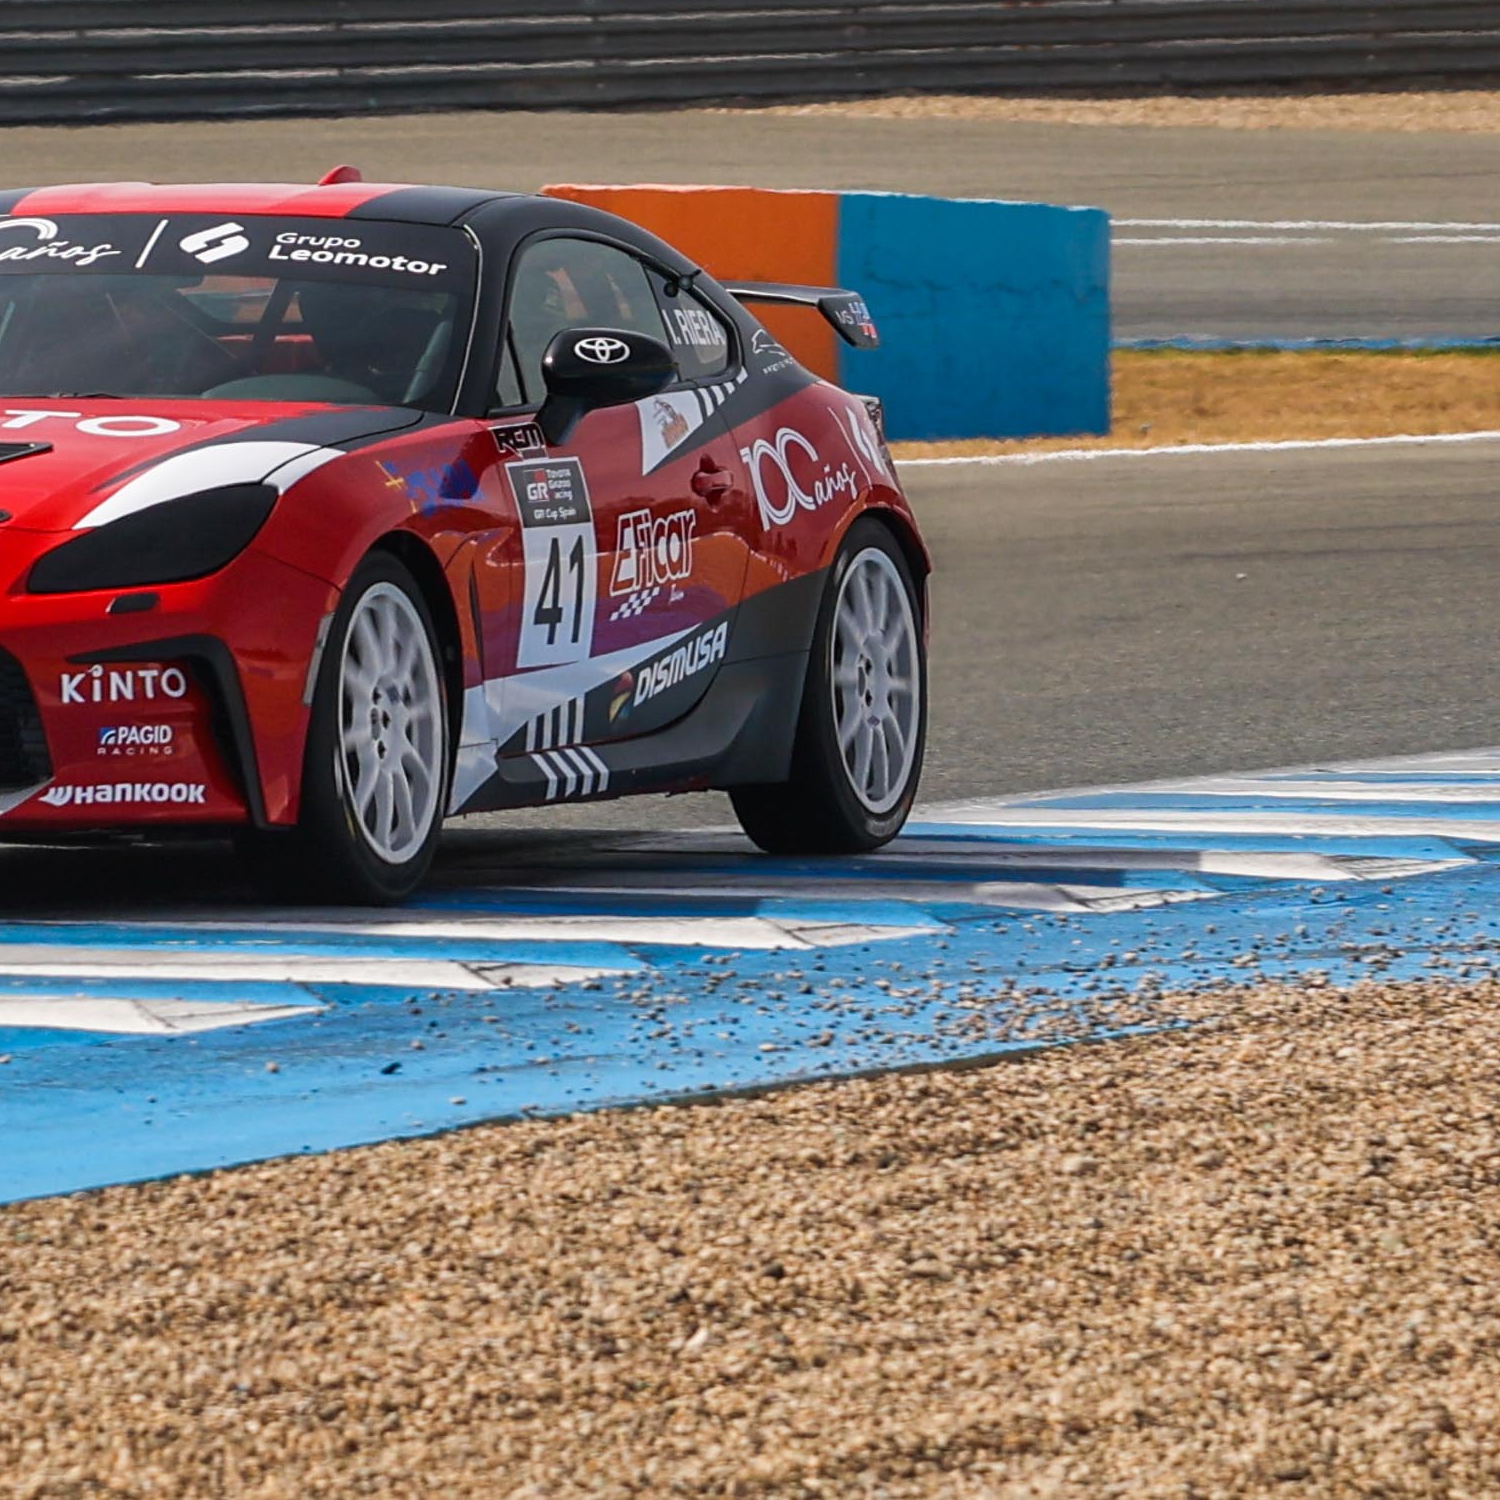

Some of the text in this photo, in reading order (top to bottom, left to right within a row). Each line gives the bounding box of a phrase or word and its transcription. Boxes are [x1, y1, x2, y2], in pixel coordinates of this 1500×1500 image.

[275, 232, 362, 250] Grupo
[267, 244, 448, 276] Leomotor
[674, 309, 726, 347] RIERA
[526, 482, 550, 502] GR
[532, 534, 587, 646] 41
[632, 620, 729, 708] DISMUSA
[116, 724, 173, 746] PAGID
[96, 746, 173, 756] RACING
